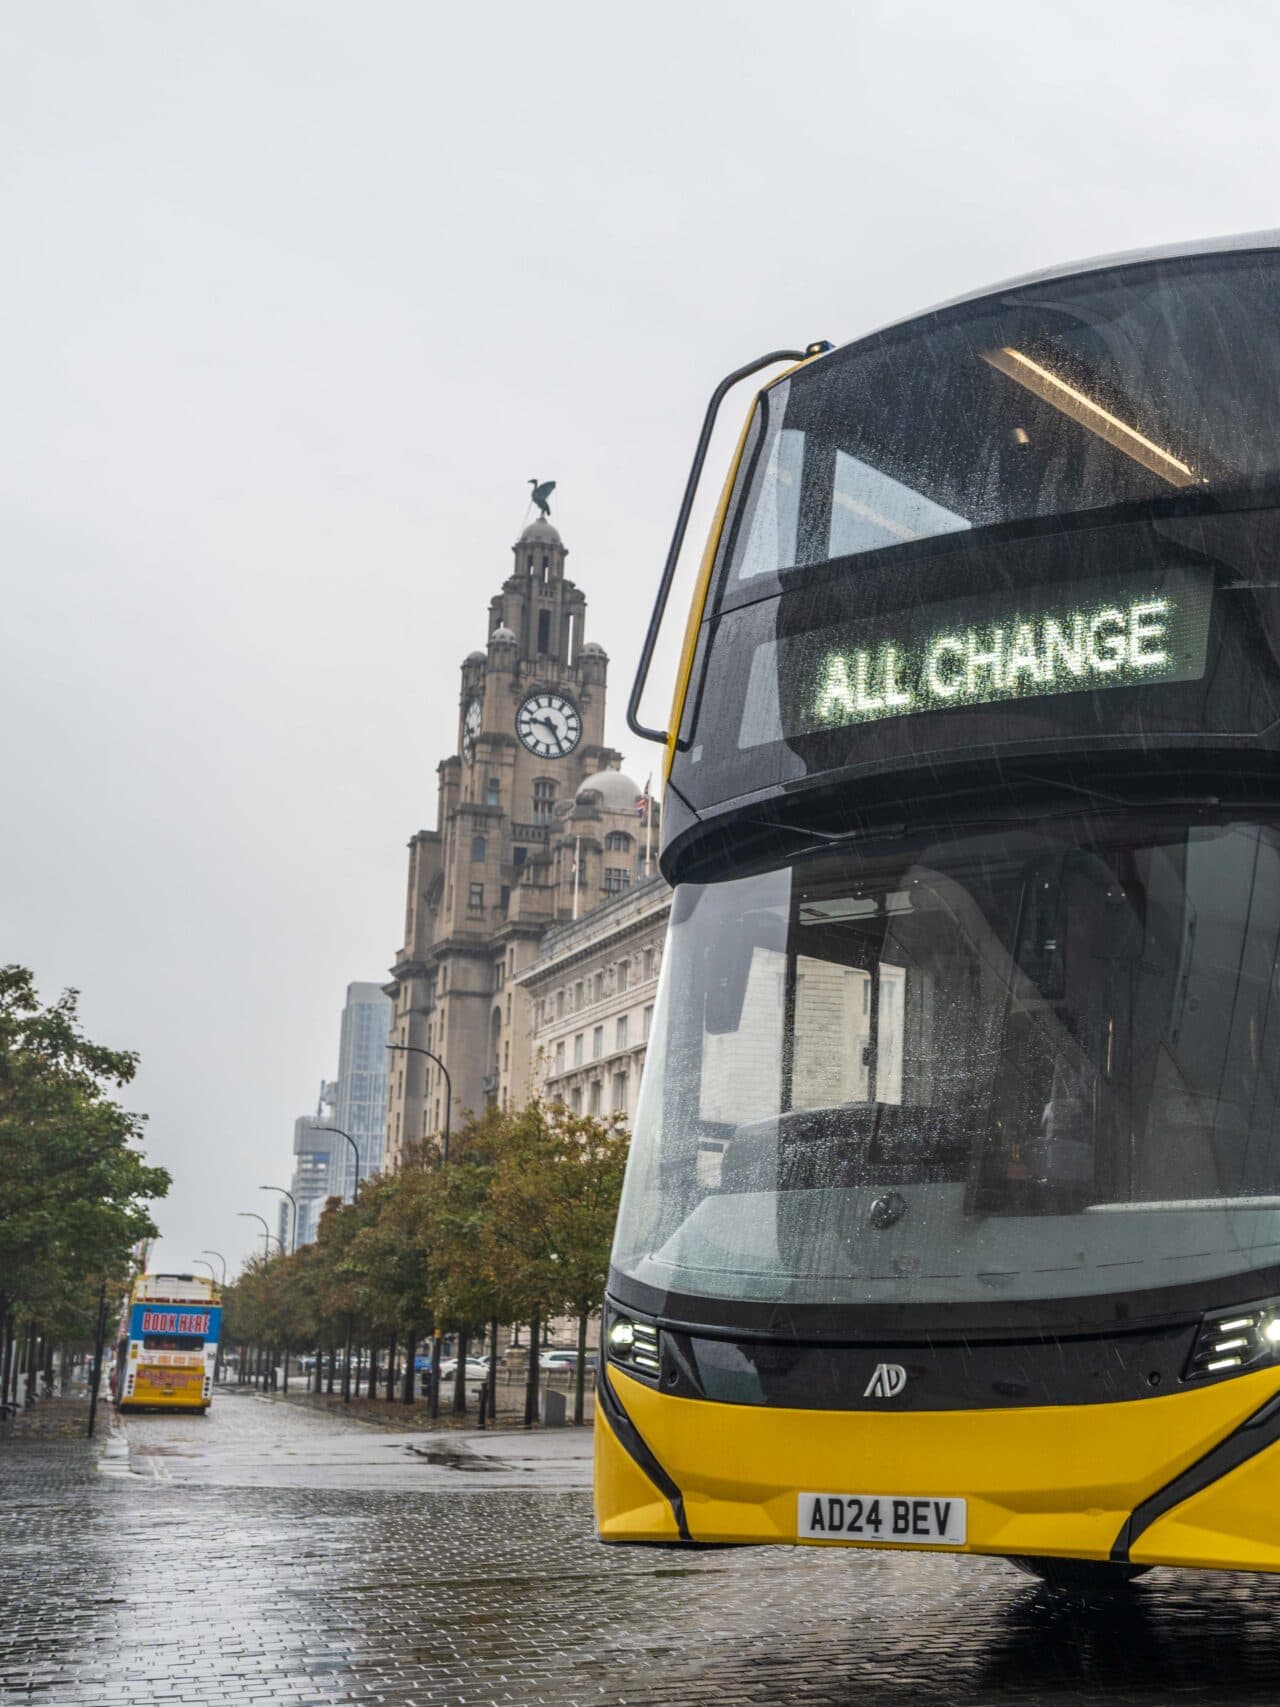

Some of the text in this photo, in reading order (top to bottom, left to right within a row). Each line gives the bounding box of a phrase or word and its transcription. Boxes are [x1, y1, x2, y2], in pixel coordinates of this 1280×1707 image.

[811, 598, 1169, 718] ALL CHANGE
[142, 1311, 211, 1334] BOOK HERE
[810, 1497, 952, 1537] AD24 BEV
